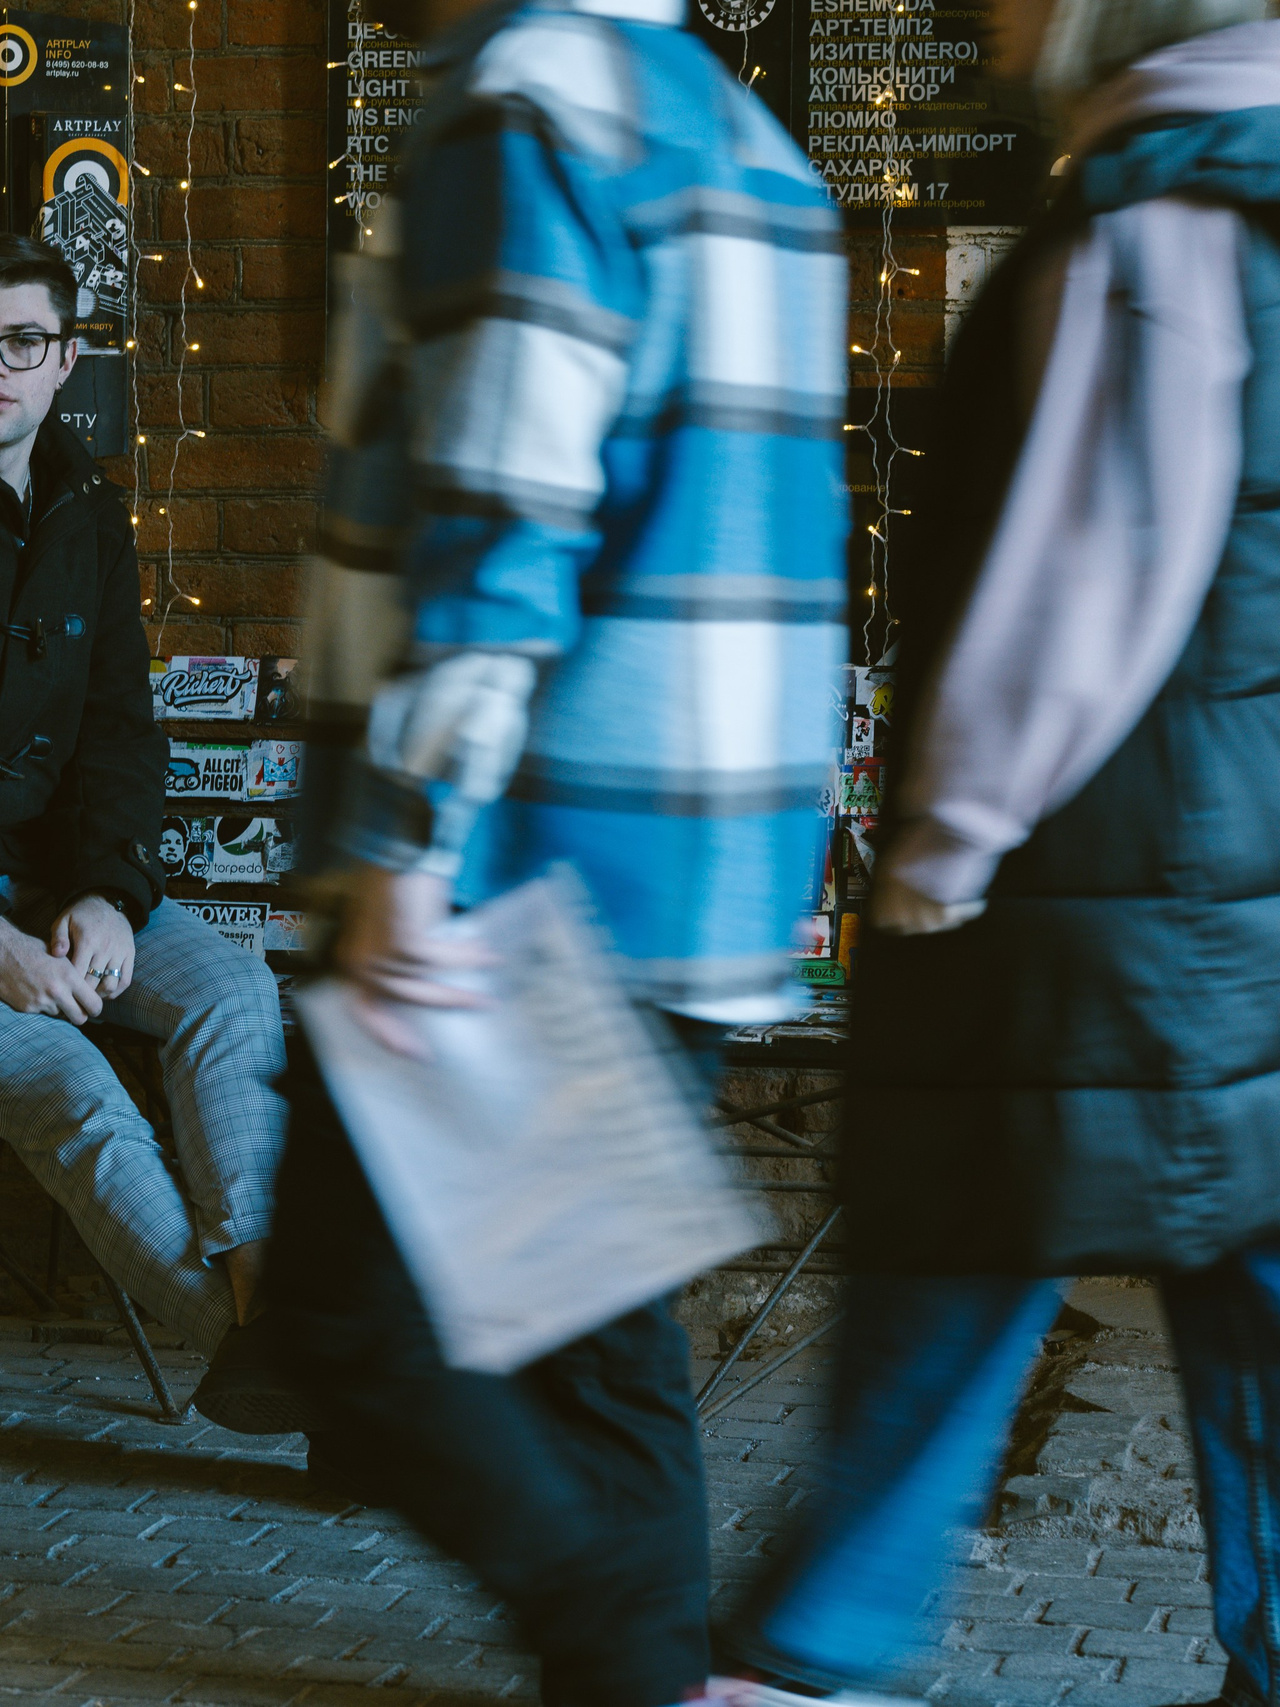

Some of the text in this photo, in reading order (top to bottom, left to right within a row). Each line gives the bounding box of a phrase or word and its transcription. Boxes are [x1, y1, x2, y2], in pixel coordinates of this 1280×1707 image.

[811, 0, 935, 12] ESHEMDA
[809, 11, 882, 20] дизайнерские
[929, 10, 991, 20] аксессуары
[809, 18, 933, 37] АРТ-ТЕМП2
[46, 39, 92, 49] ARTPLAY
[347, 40, 420, 49] псональные
[809, 35, 882, 43] строительная
[45, 49, 72, 60] INFO
[810, 41, 978, 64] ИЗИТЕК (NERO)
[45, 60, 109, 69] 8 (495) 620-08-83
[809, 60, 854, 68] системы
[858, 60, 891, 68] умного
[45, 69, 79, 78] artplay.ru
[810, 66, 955, 85] КОМЬЮНИТИ
[347, 79, 410, 97] LIGHT
[808, 84, 940, 102] АКТИВАТОР
[347, 98, 390, 108] шу-рум
[808, 103, 864, 112] рекламное
[918, 102, 987, 112] издательство
[347, 108, 378, 126] MS
[808, 111, 897, 128] ЛЮМИО
[53, 119, 122, 132] ARTPLAY
[808, 127, 868, 135] необычные
[871, 127, 936, 135] свеильники
[949, 126, 978, 135] вещи
[347, 135, 389, 153] RTC
[809, 134, 1017, 152] РЕКЛАМА-ИМПОРТ
[857, 151, 929, 160] произодство
[934, 151, 978, 159] вывесок
[346, 164, 388, 182] THE
[808, 159, 913, 177] САХАРОК
[852, 175, 910, 184] украший
[822, 183, 895, 204] ТУДИЯ
[926, 182, 949, 200] 17
[923, 199, 985, 209] интерьеров
[90, 321, 114, 331] карту
[60, 413, 97, 429] РТУ
[213, 862, 264, 875] torpedo
[801, 967, 836, 978] FROZ5
